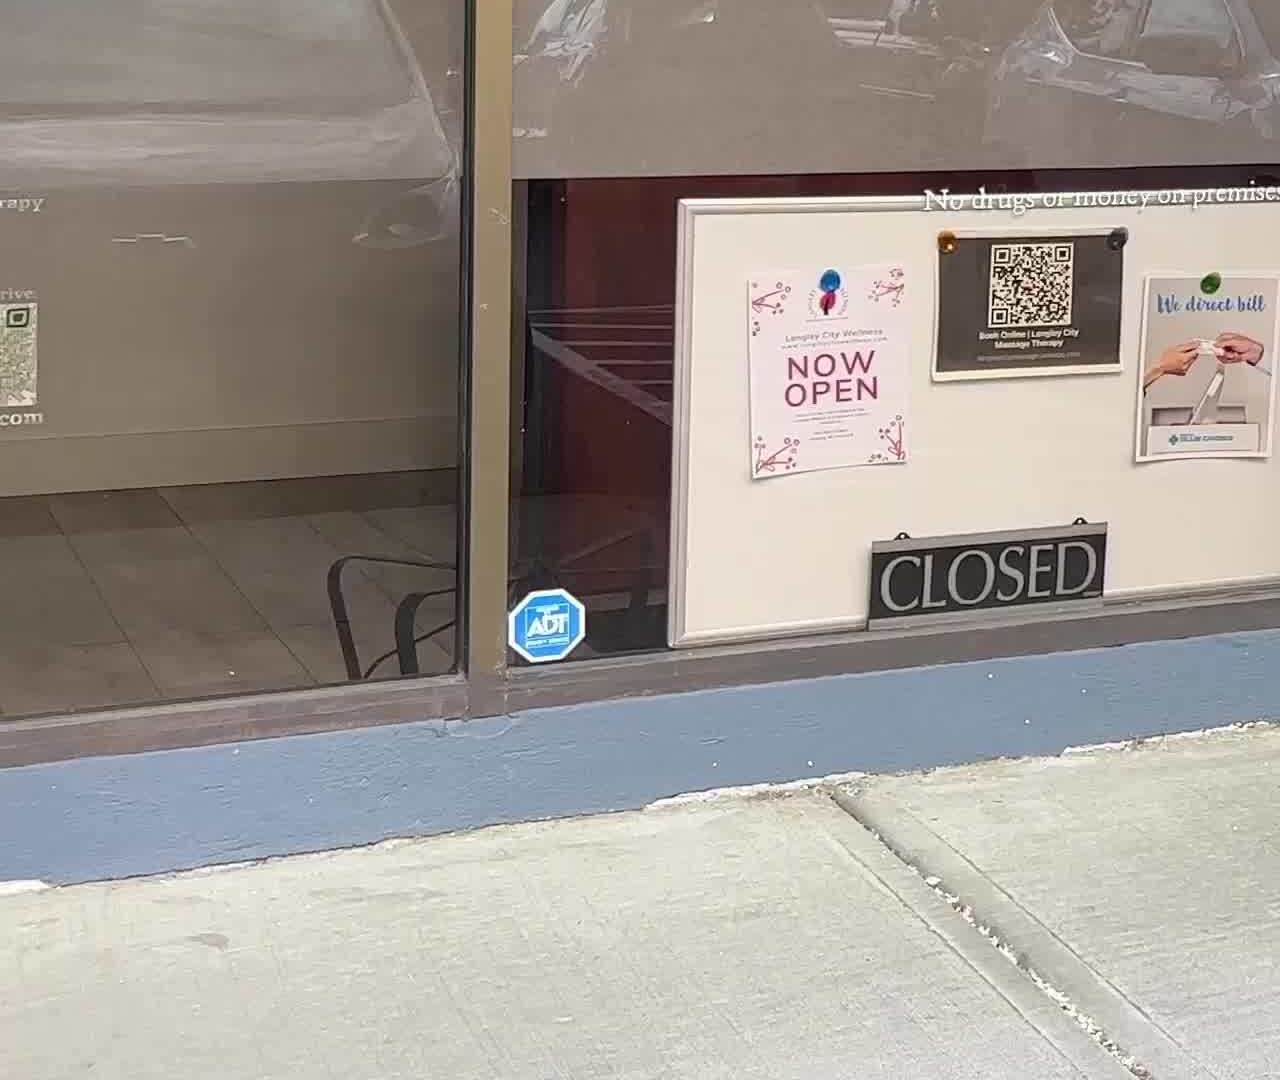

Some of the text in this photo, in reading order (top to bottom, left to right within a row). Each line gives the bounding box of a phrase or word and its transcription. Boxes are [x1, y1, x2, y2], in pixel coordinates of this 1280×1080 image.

[923, 189, 963, 211] No
[971, 186, 1035, 216] drugs
[1073, 191, 1151, 208] money
[1158, 190, 1185, 204] on
[1157, 294, 1267, 313] We direct bill
[788, 350, 875, 380] NOW
[784, 376, 878, 407] OPEN
[880, 541, 1097, 611] CLOSED
[528, 613, 569, 638] ADT
